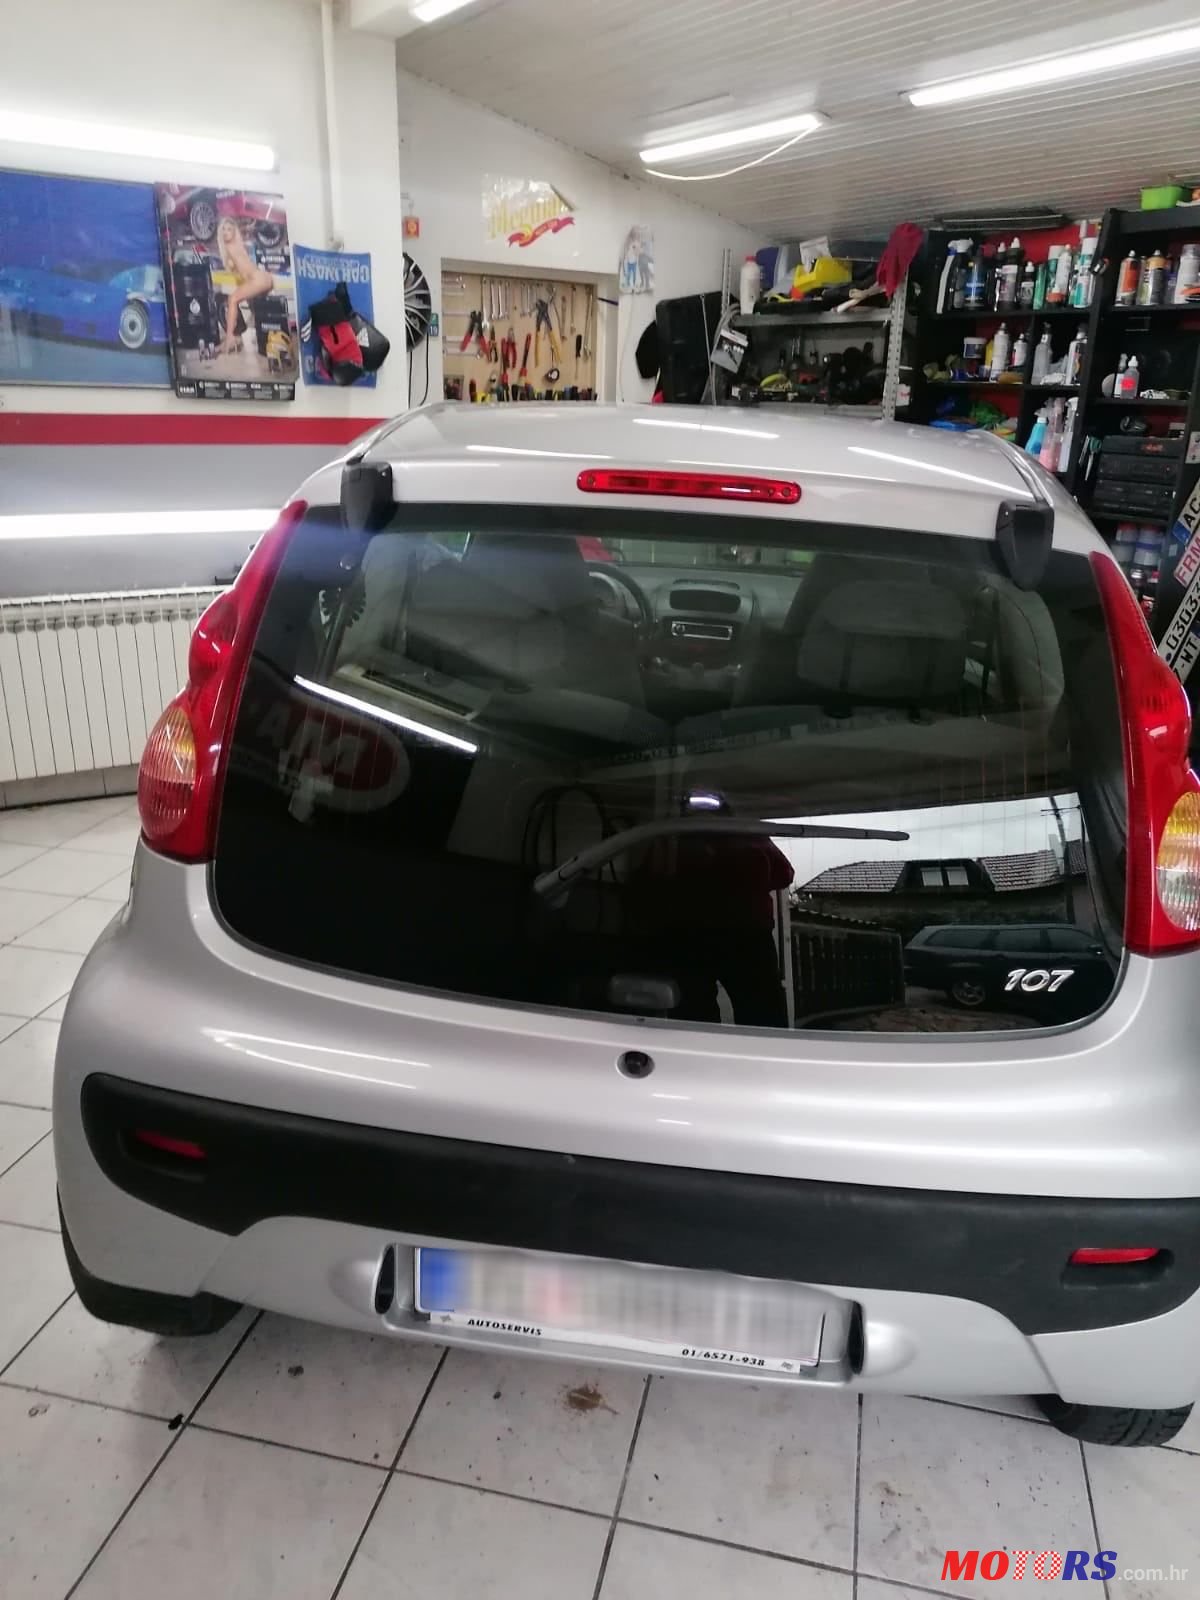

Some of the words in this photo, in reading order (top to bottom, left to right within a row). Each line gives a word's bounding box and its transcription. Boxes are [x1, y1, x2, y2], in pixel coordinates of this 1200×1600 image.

[1004, 968, 1075, 992] 107
[467, 1319, 543, 1336] AUTOSERVIS
[681, 1348, 765, 1366] 01/6571-938
